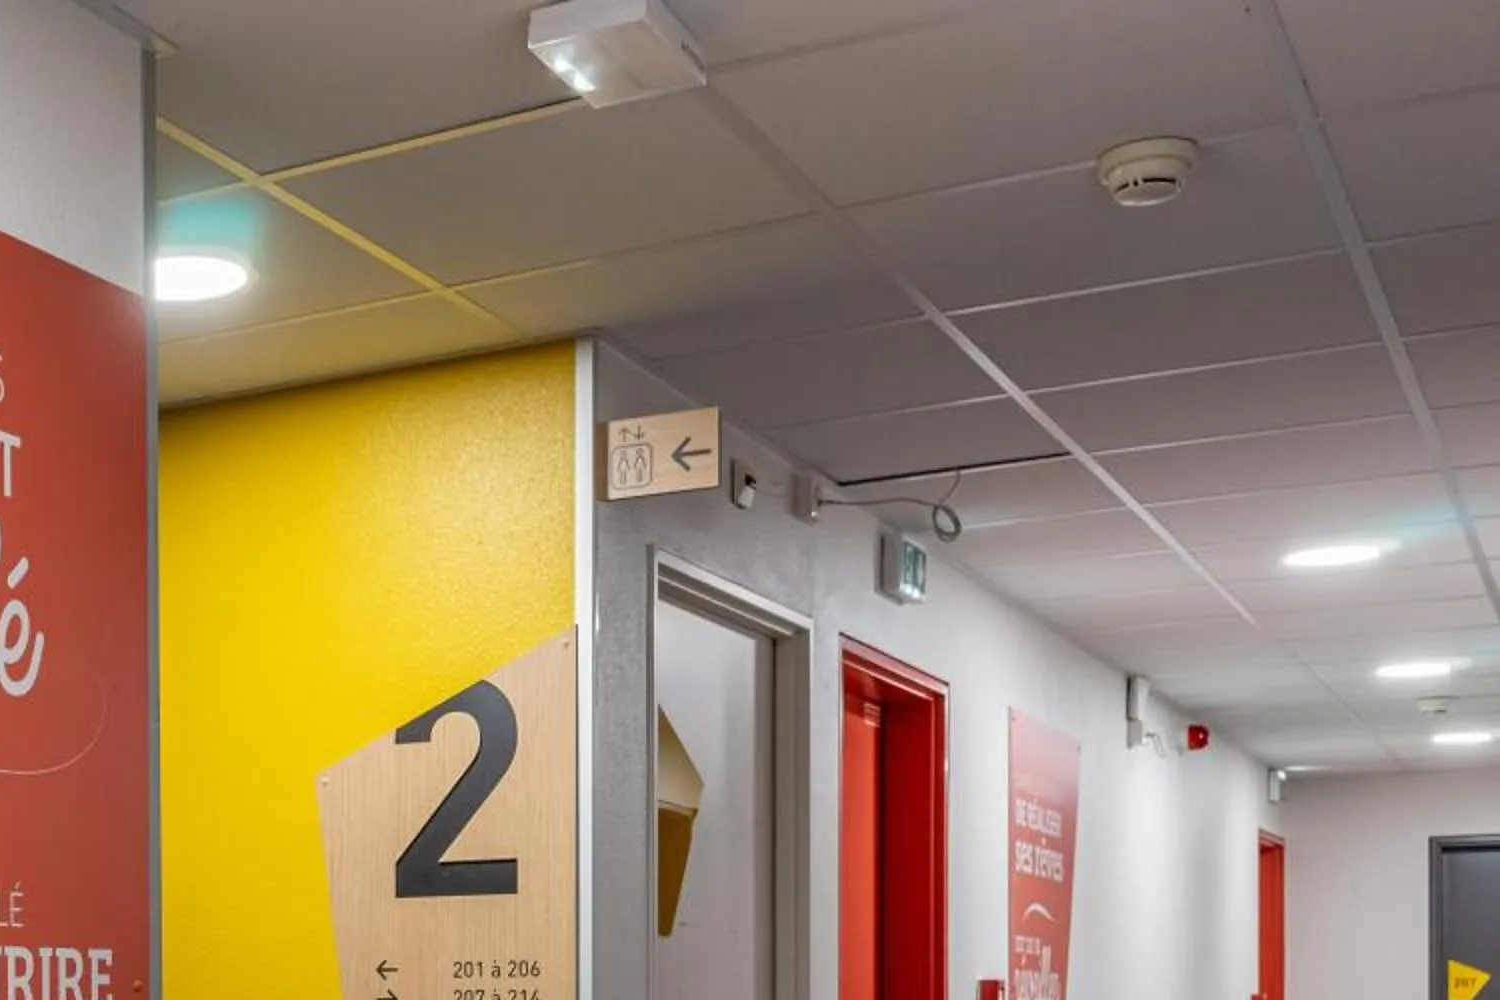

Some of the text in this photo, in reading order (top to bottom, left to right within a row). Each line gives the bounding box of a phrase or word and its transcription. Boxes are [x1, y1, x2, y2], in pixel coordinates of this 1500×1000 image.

[395, 679, 519, 898] 2
[453, 960, 541, 979] 201 à 206
